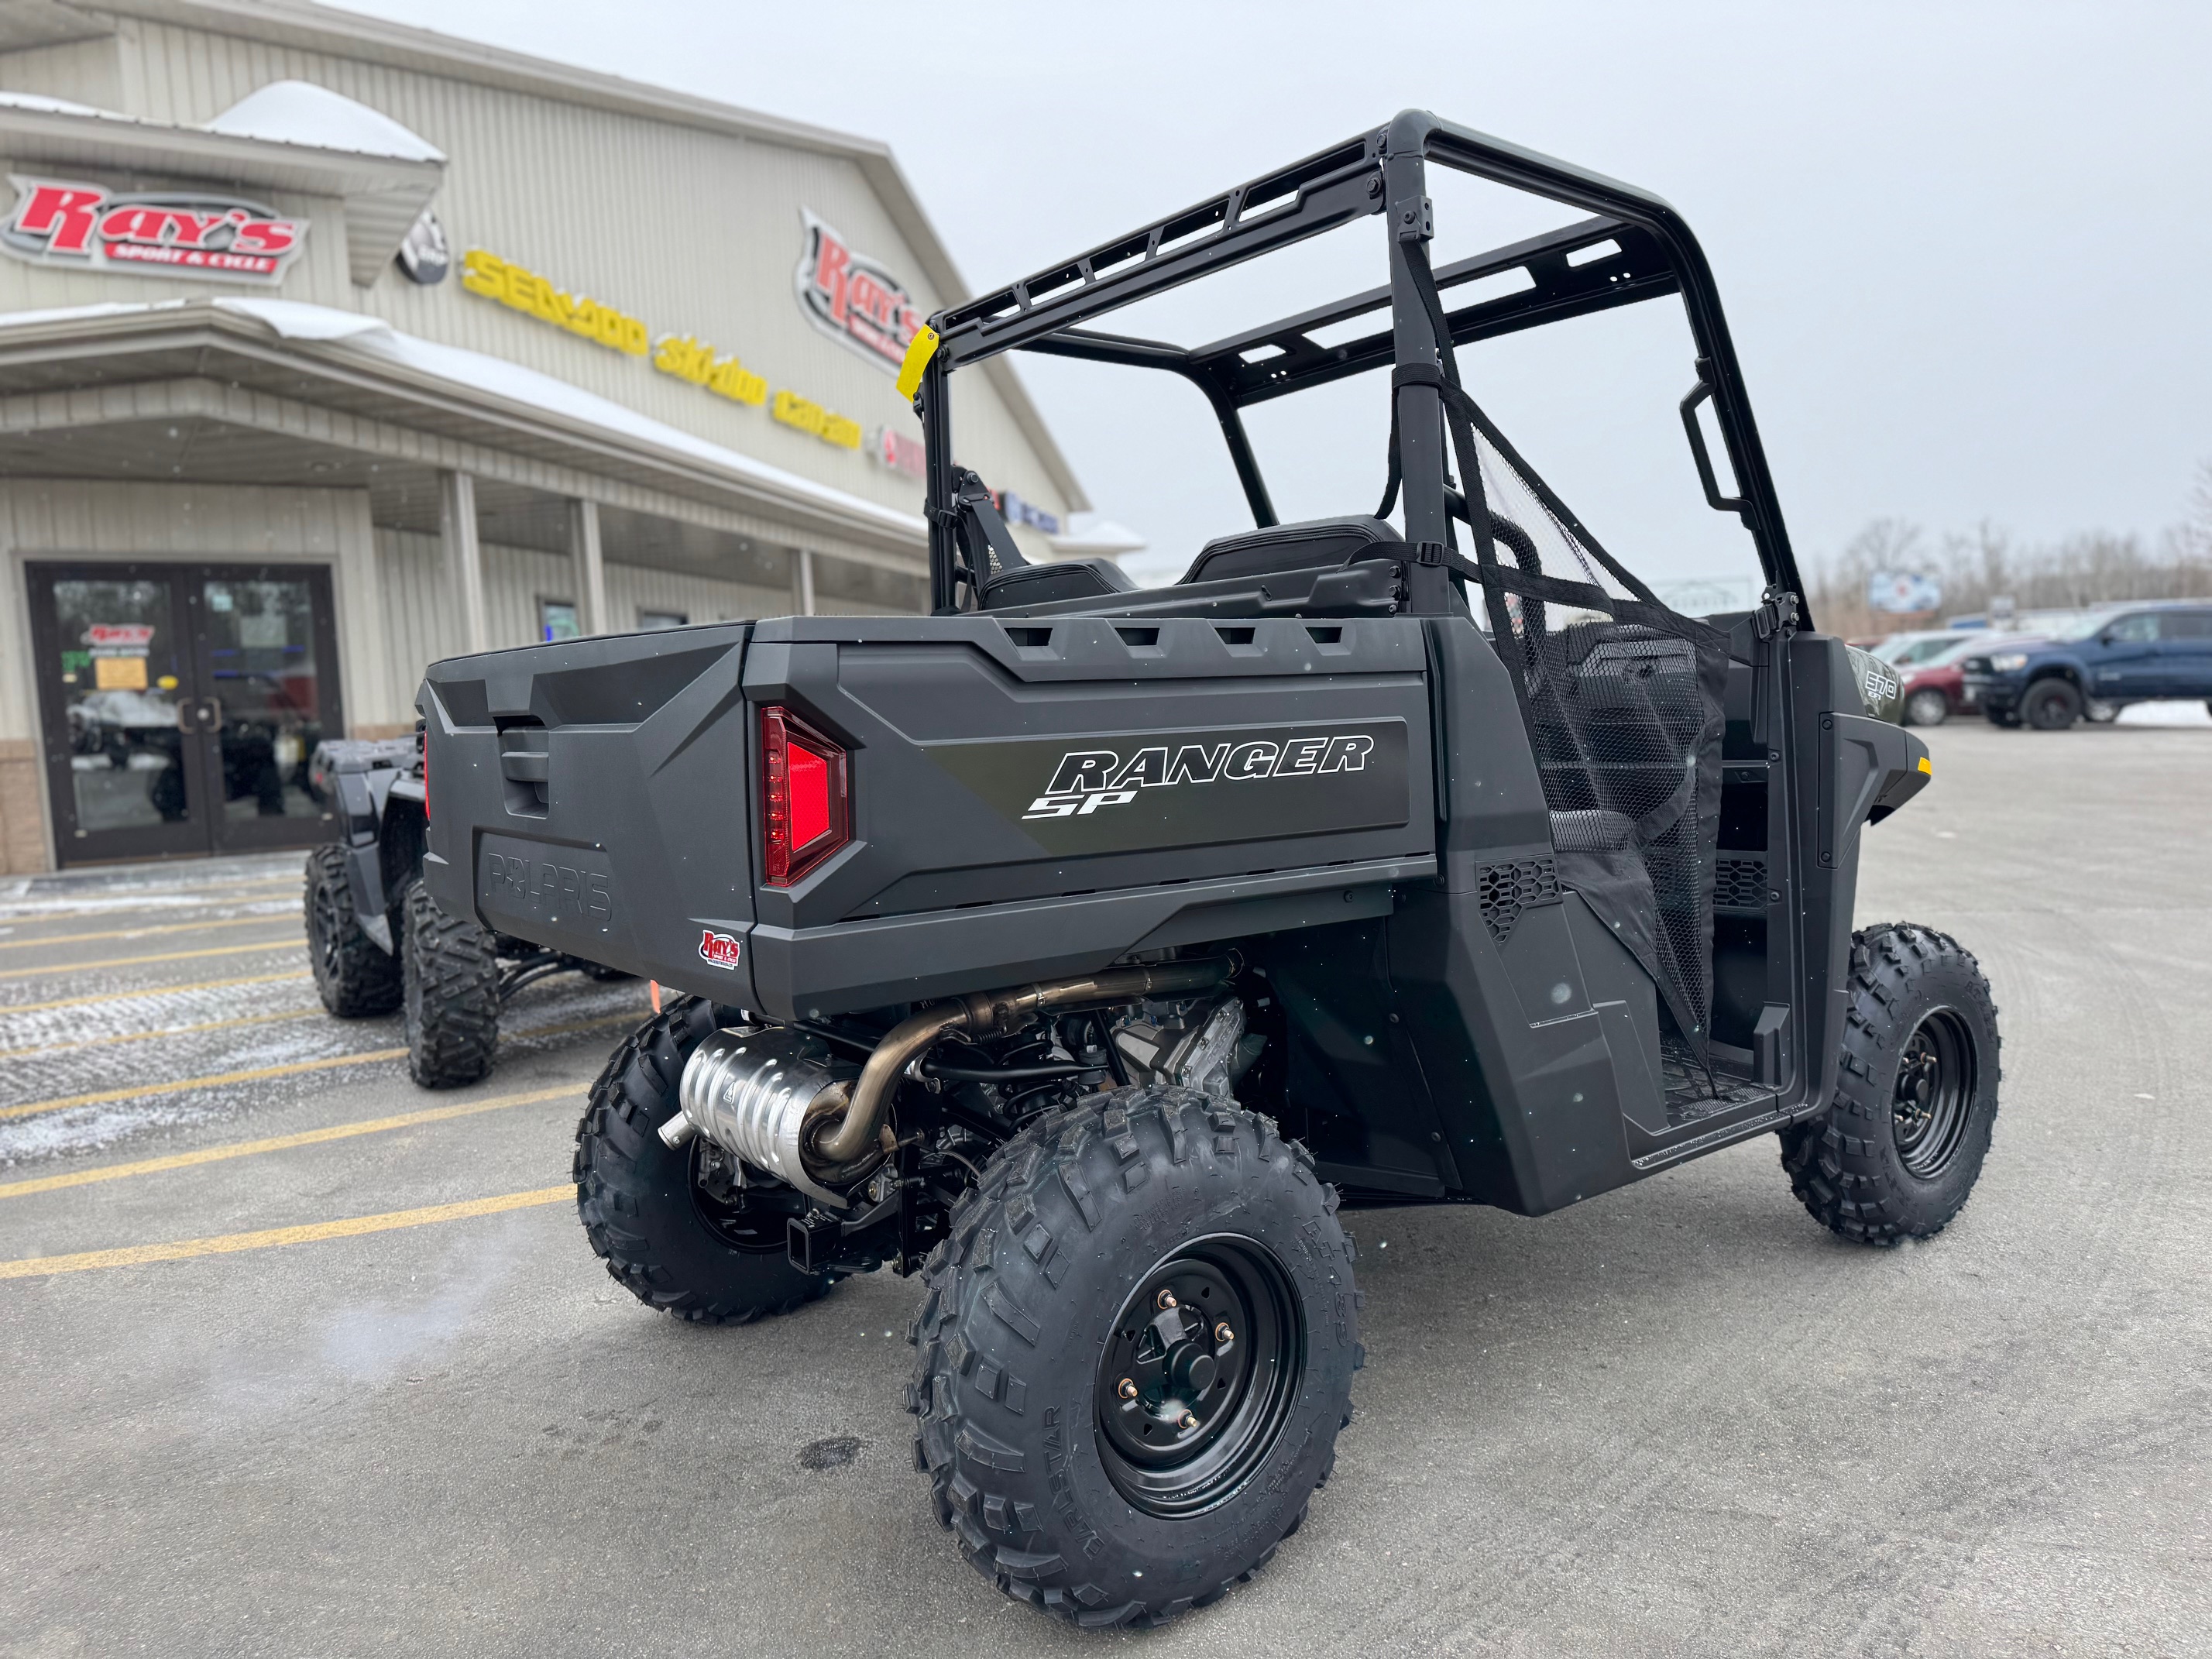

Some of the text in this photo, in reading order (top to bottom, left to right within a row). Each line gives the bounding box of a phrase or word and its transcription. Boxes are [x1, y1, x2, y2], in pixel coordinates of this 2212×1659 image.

[19, 185, 296, 252] Ray's
[115, 243, 270, 270] SPORT & CYCLE
[1865, 670, 1897, 700] 570
[1867, 690, 1881, 701] EFI
[1045, 734, 1375, 795] RANGER
[1021, 790, 1139, 820] SP
[487, 852, 613, 922] POLARIS
[1043, 1405, 1105, 1560] CARLSTAR
